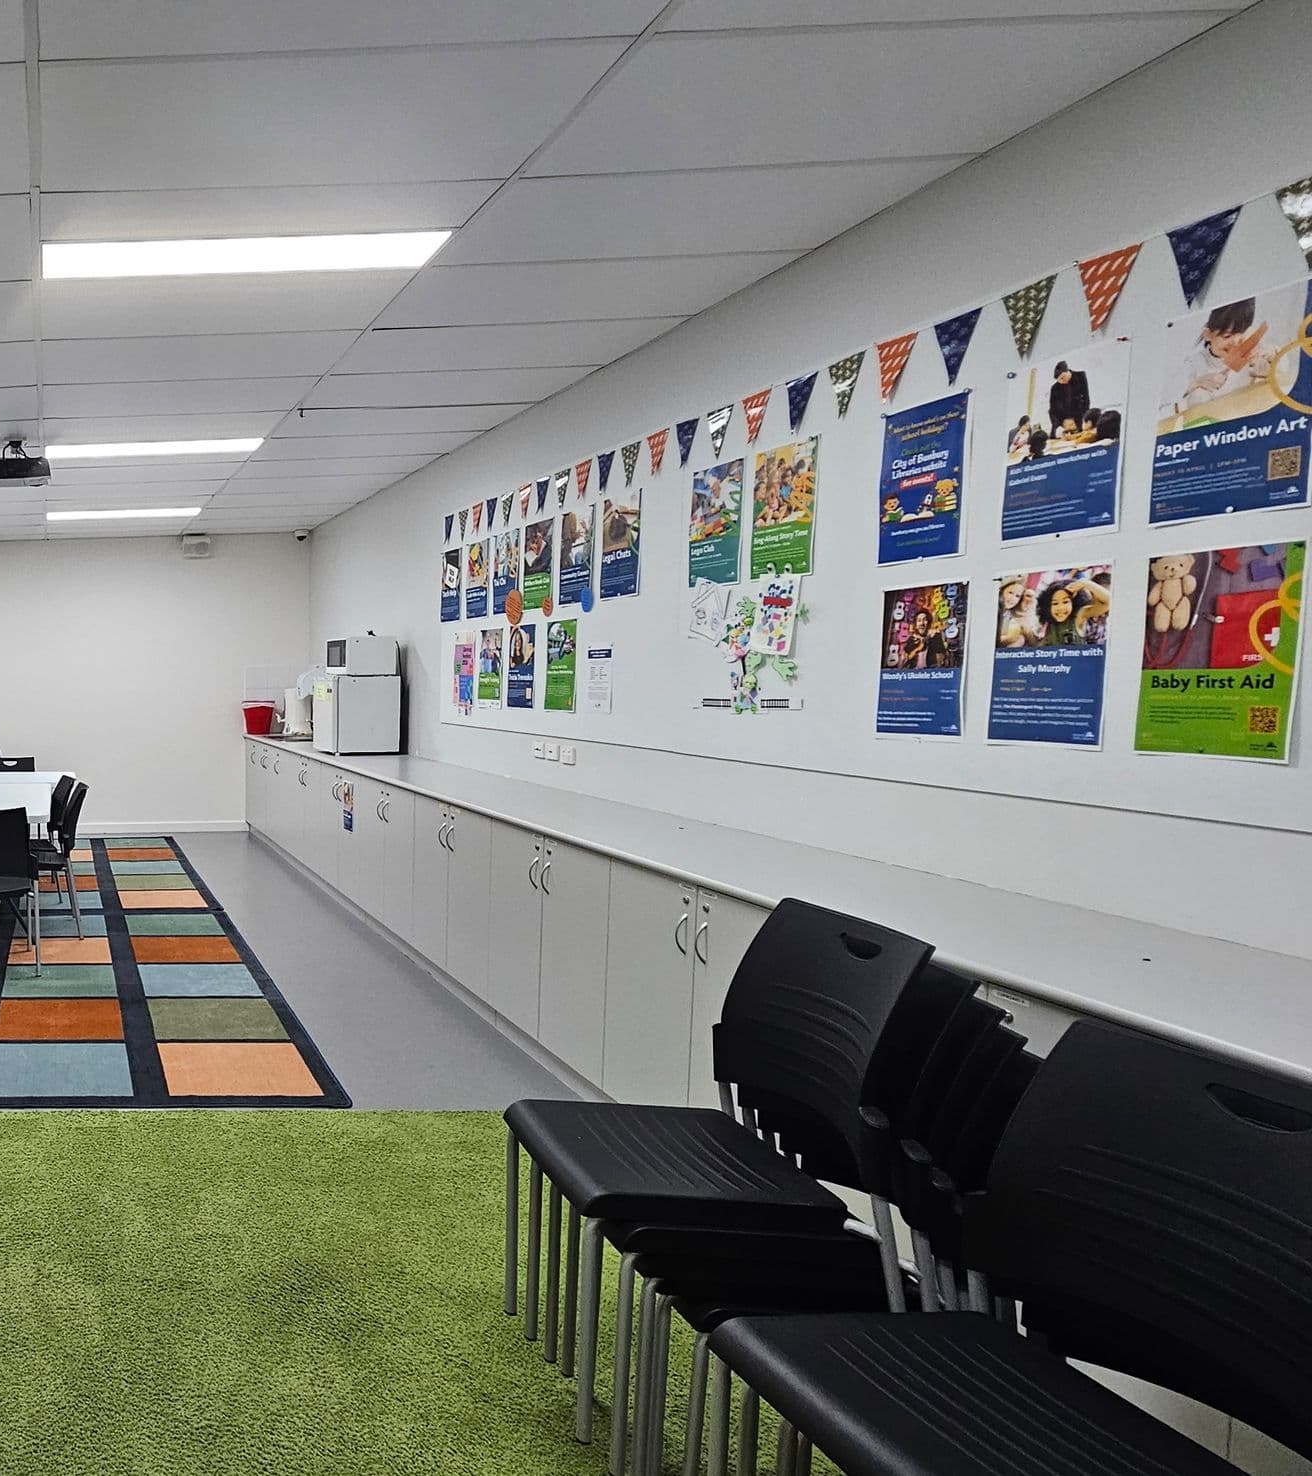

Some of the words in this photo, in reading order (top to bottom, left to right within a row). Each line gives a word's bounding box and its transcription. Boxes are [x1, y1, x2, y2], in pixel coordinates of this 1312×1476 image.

[1155, 438, 1200, 458] Paper
[1203, 425, 1272, 448] Window
[1275, 416, 1308, 435] Art
[892, 459, 907, 471] City
[908, 457, 916, 467] of
[917, 450, 949, 464] Bunbury
[891, 466, 921, 480] Libraries
[616, 549, 631, 559] Chats
[691, 547, 703, 556] Lego
[704, 544, 715, 553] Club
[995, 650, 1034, 659] Interactive
[1035, 649, 1058, 659] Story
[1059, 648, 1080, 657] Time
[1082, 648, 1103, 656] with
[1017, 664, 1036, 674] Sally
[1038, 664, 1071, 674] Murphy
[882, 672, 907, 681] Woody's
[908, 671, 930, 680] Ukulele
[931, 671, 954, 679] School
[1151, 675, 1191, 693] Baby
[1196, 674, 1235, 689] First
[1239, 673, 1275, 689] Aid
